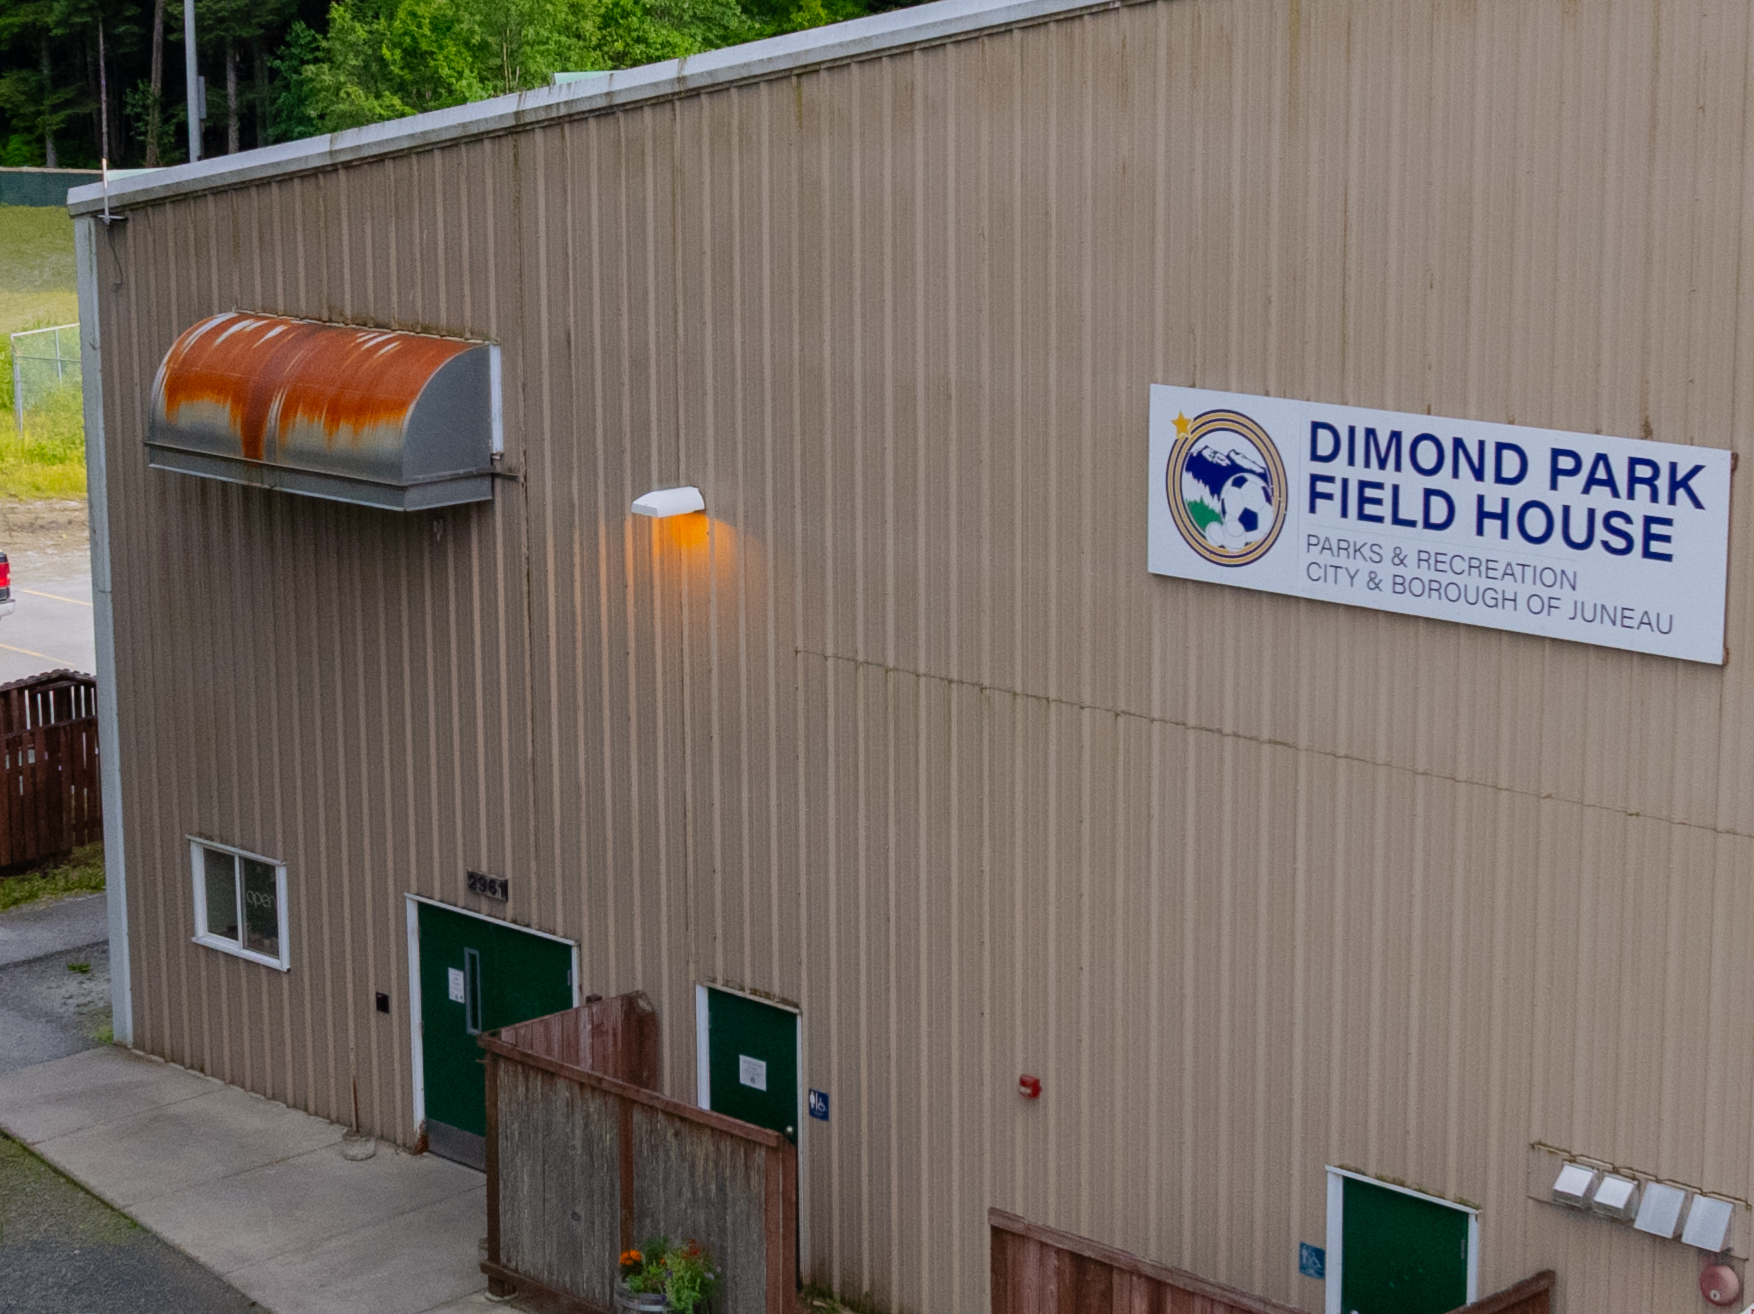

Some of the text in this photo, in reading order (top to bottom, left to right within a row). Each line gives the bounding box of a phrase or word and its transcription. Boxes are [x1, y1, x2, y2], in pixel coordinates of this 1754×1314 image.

[1308, 420, 1707, 511] DIMOND PARK
[1307, 473, 1675, 563] FIELD HOUSE
[1305, 561, 1675, 636] CITY & BOROUGH OF JUNEAU
[1306, 534, 1578, 592] PARKS & RECREATION
[468, 873, 505, 899] 2961
